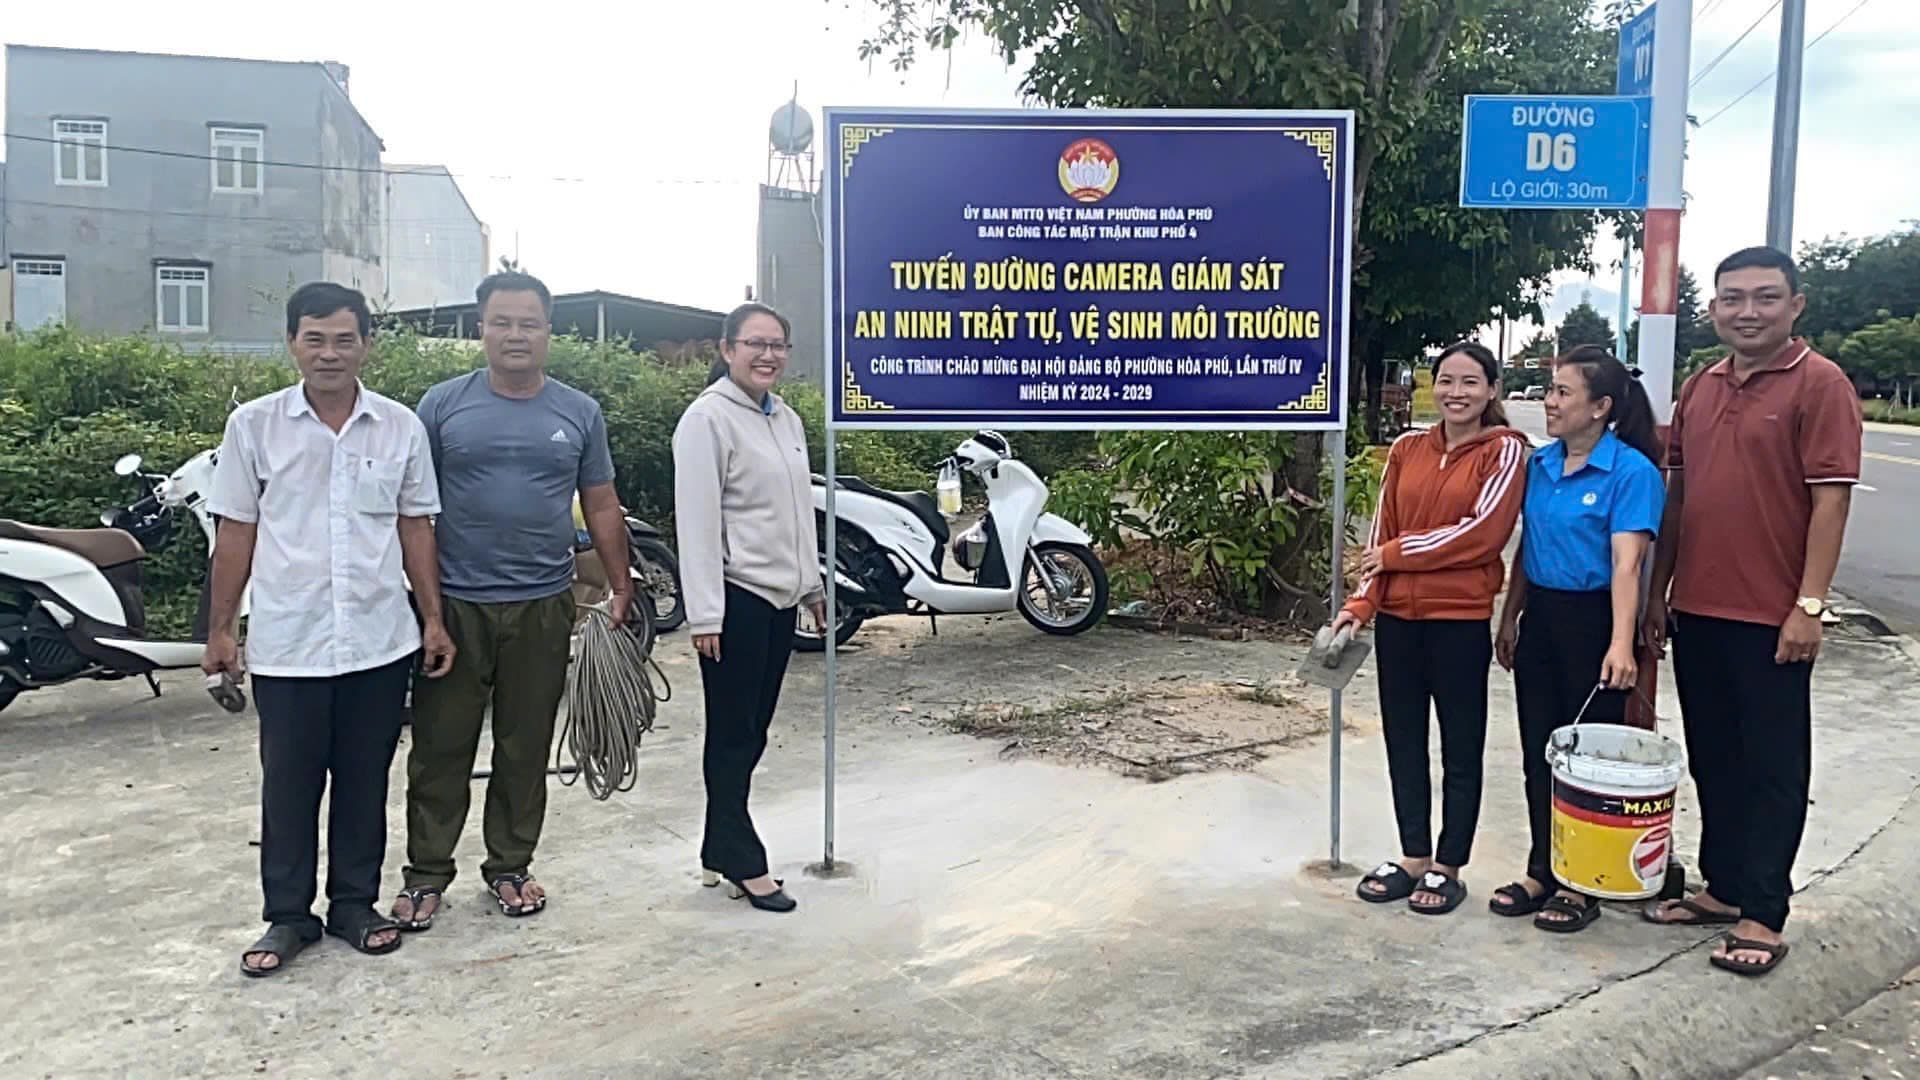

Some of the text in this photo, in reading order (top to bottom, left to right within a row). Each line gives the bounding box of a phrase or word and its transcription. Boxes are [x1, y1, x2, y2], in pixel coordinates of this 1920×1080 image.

[1512, 103, 1594, 127] ĐƯỜNG
[1526, 132, 1576, 171] D6
[1490, 178, 1608, 201] LỘ GIỚI: 30m
[963, 204, 979, 220] ỦY
[982, 207, 1008, 220] BAN
[1011, 207, 1044, 221] MTTQ
[1047, 206, 1073, 222] VIỆT
[1075, 207, 1104, 220] NAM
[1107, 206, 1157, 220] PHƯỜNG
[978, 223, 1197, 241] BAN CÔNG TÁC MẶT TRẬN KHU PHỐ 4
[891, 252, 1285, 291] TUYẾN ĐƯỜNG CAMERA GIÁM SÁT
[854, 304, 1320, 345] AN NINH TRẬT TỰ, VỆ SINH MÔI TRƯỜNG
[870, 355, 903, 375] CÔNG
[906, 356, 943, 375] TRÌNH
[946, 356, 979, 375] CHÀO
[982, 356, 1018, 375] MỪNG
[1021, 359, 1042, 378] ĐẠI
[1045, 356, 1066, 378] HỘI
[1069, 355, 1101, 375] ĐẢNG
[1104, 356, 1121, 378] BỘ
[1124, 356, 1173, 375] PHƯỜNG
[1176, 356, 1201, 375] HÒA
[1204, 356, 1233, 377] PHÚ,
[1262, 355, 1287, 375] THỨ
[1289, 359, 1303, 375] IV
[1019, 382, 1059, 403] NHIỆM
[1080, 384, 1111, 401] 2024
[1122, 384, 1153, 401] 2029
[1624, 798, 1673, 814] MAXIL
